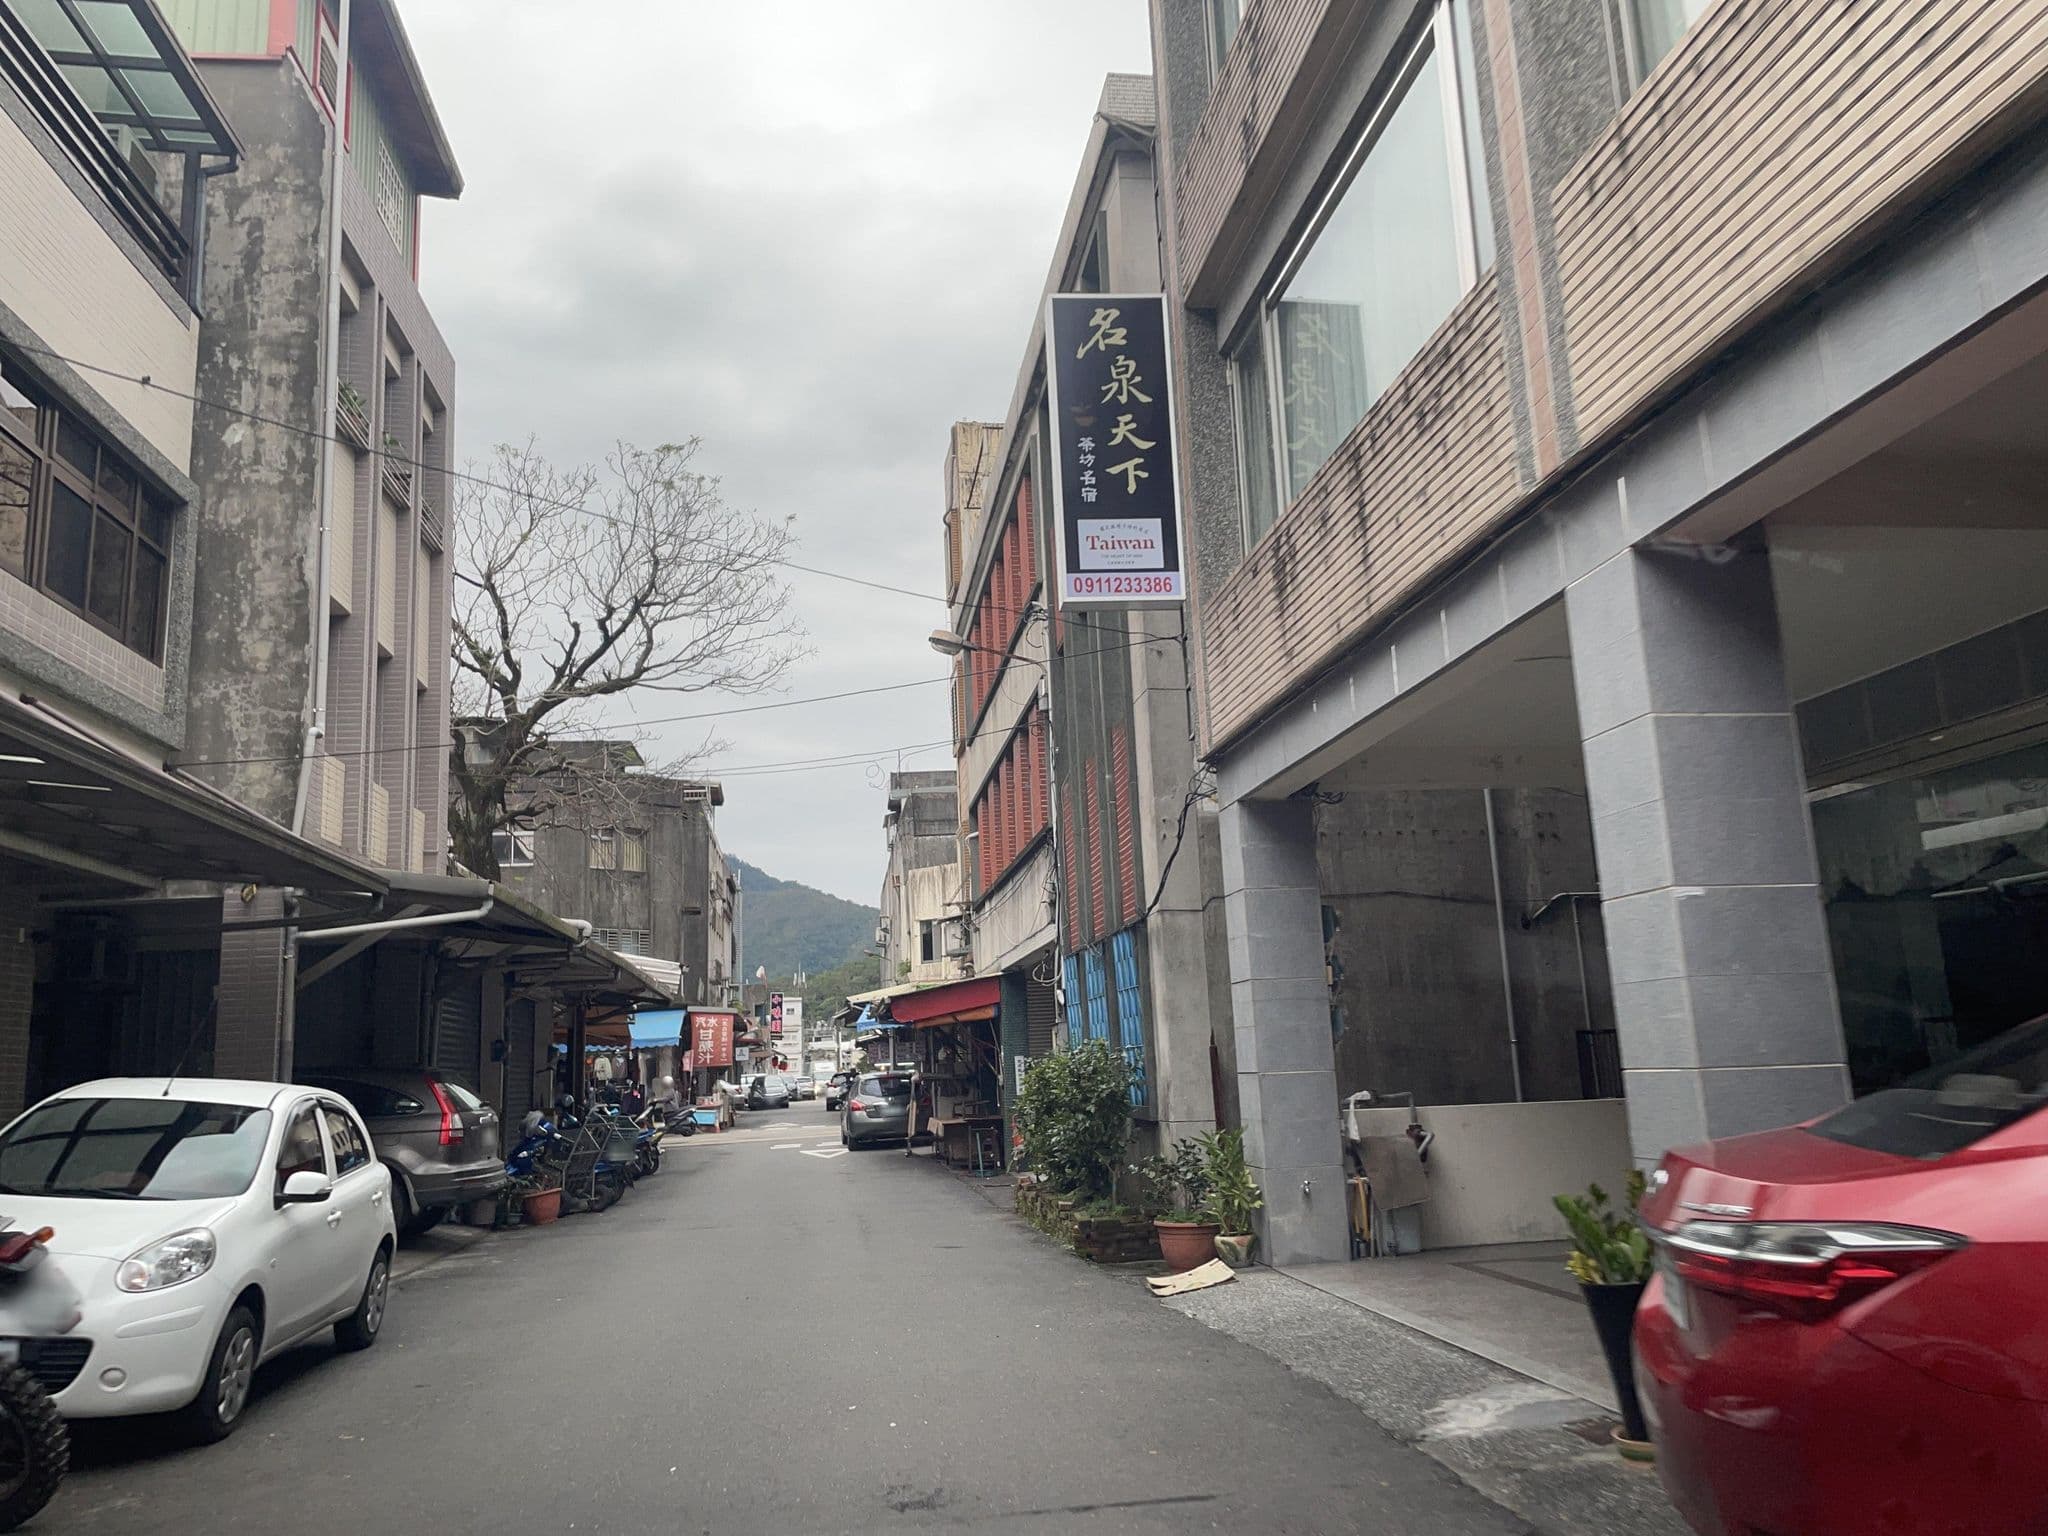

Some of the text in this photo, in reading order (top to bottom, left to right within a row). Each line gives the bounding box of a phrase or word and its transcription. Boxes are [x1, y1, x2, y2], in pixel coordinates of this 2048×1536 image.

[1076, 308, 1157, 495] 名泉天下
[1086, 535, 1155, 550] Taiwan
[1073, 576, 1172, 593] 0911233386
